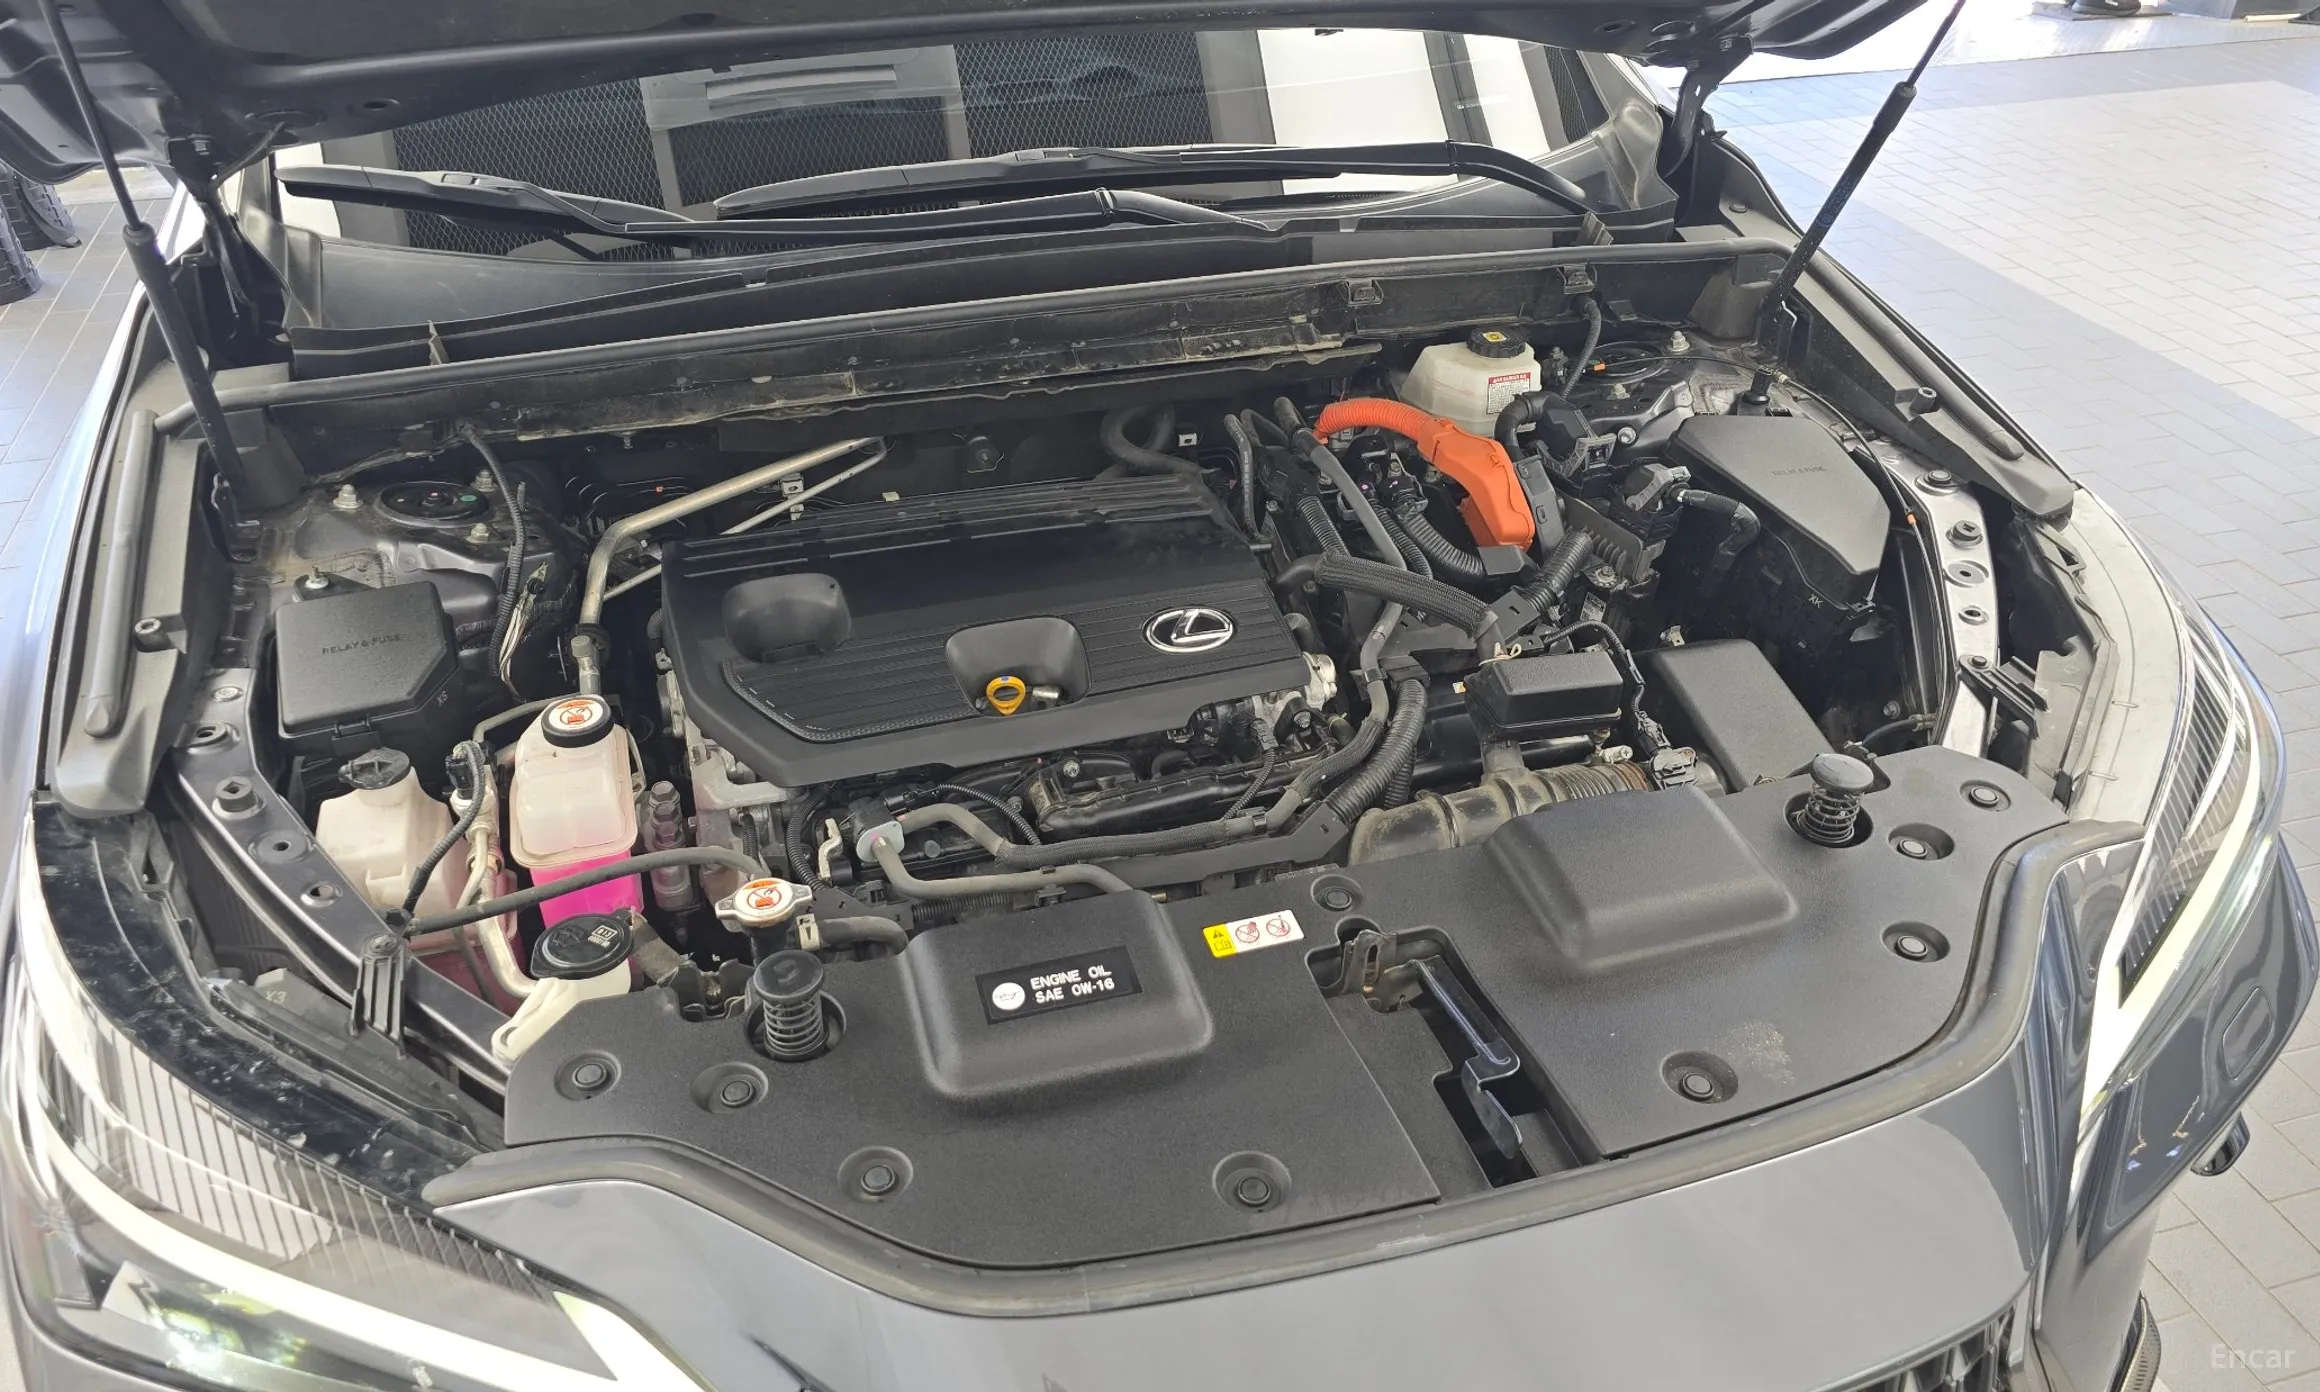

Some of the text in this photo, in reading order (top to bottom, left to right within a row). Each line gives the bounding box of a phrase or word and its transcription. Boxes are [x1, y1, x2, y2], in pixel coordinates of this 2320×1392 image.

[322, 640, 359, 655] RELAY
[372, 634, 402, 645] FUSE
[1030, 964, 1112, 990] ENGINE OIL
[1035, 978, 1115, 1004] SAE 0W-16
